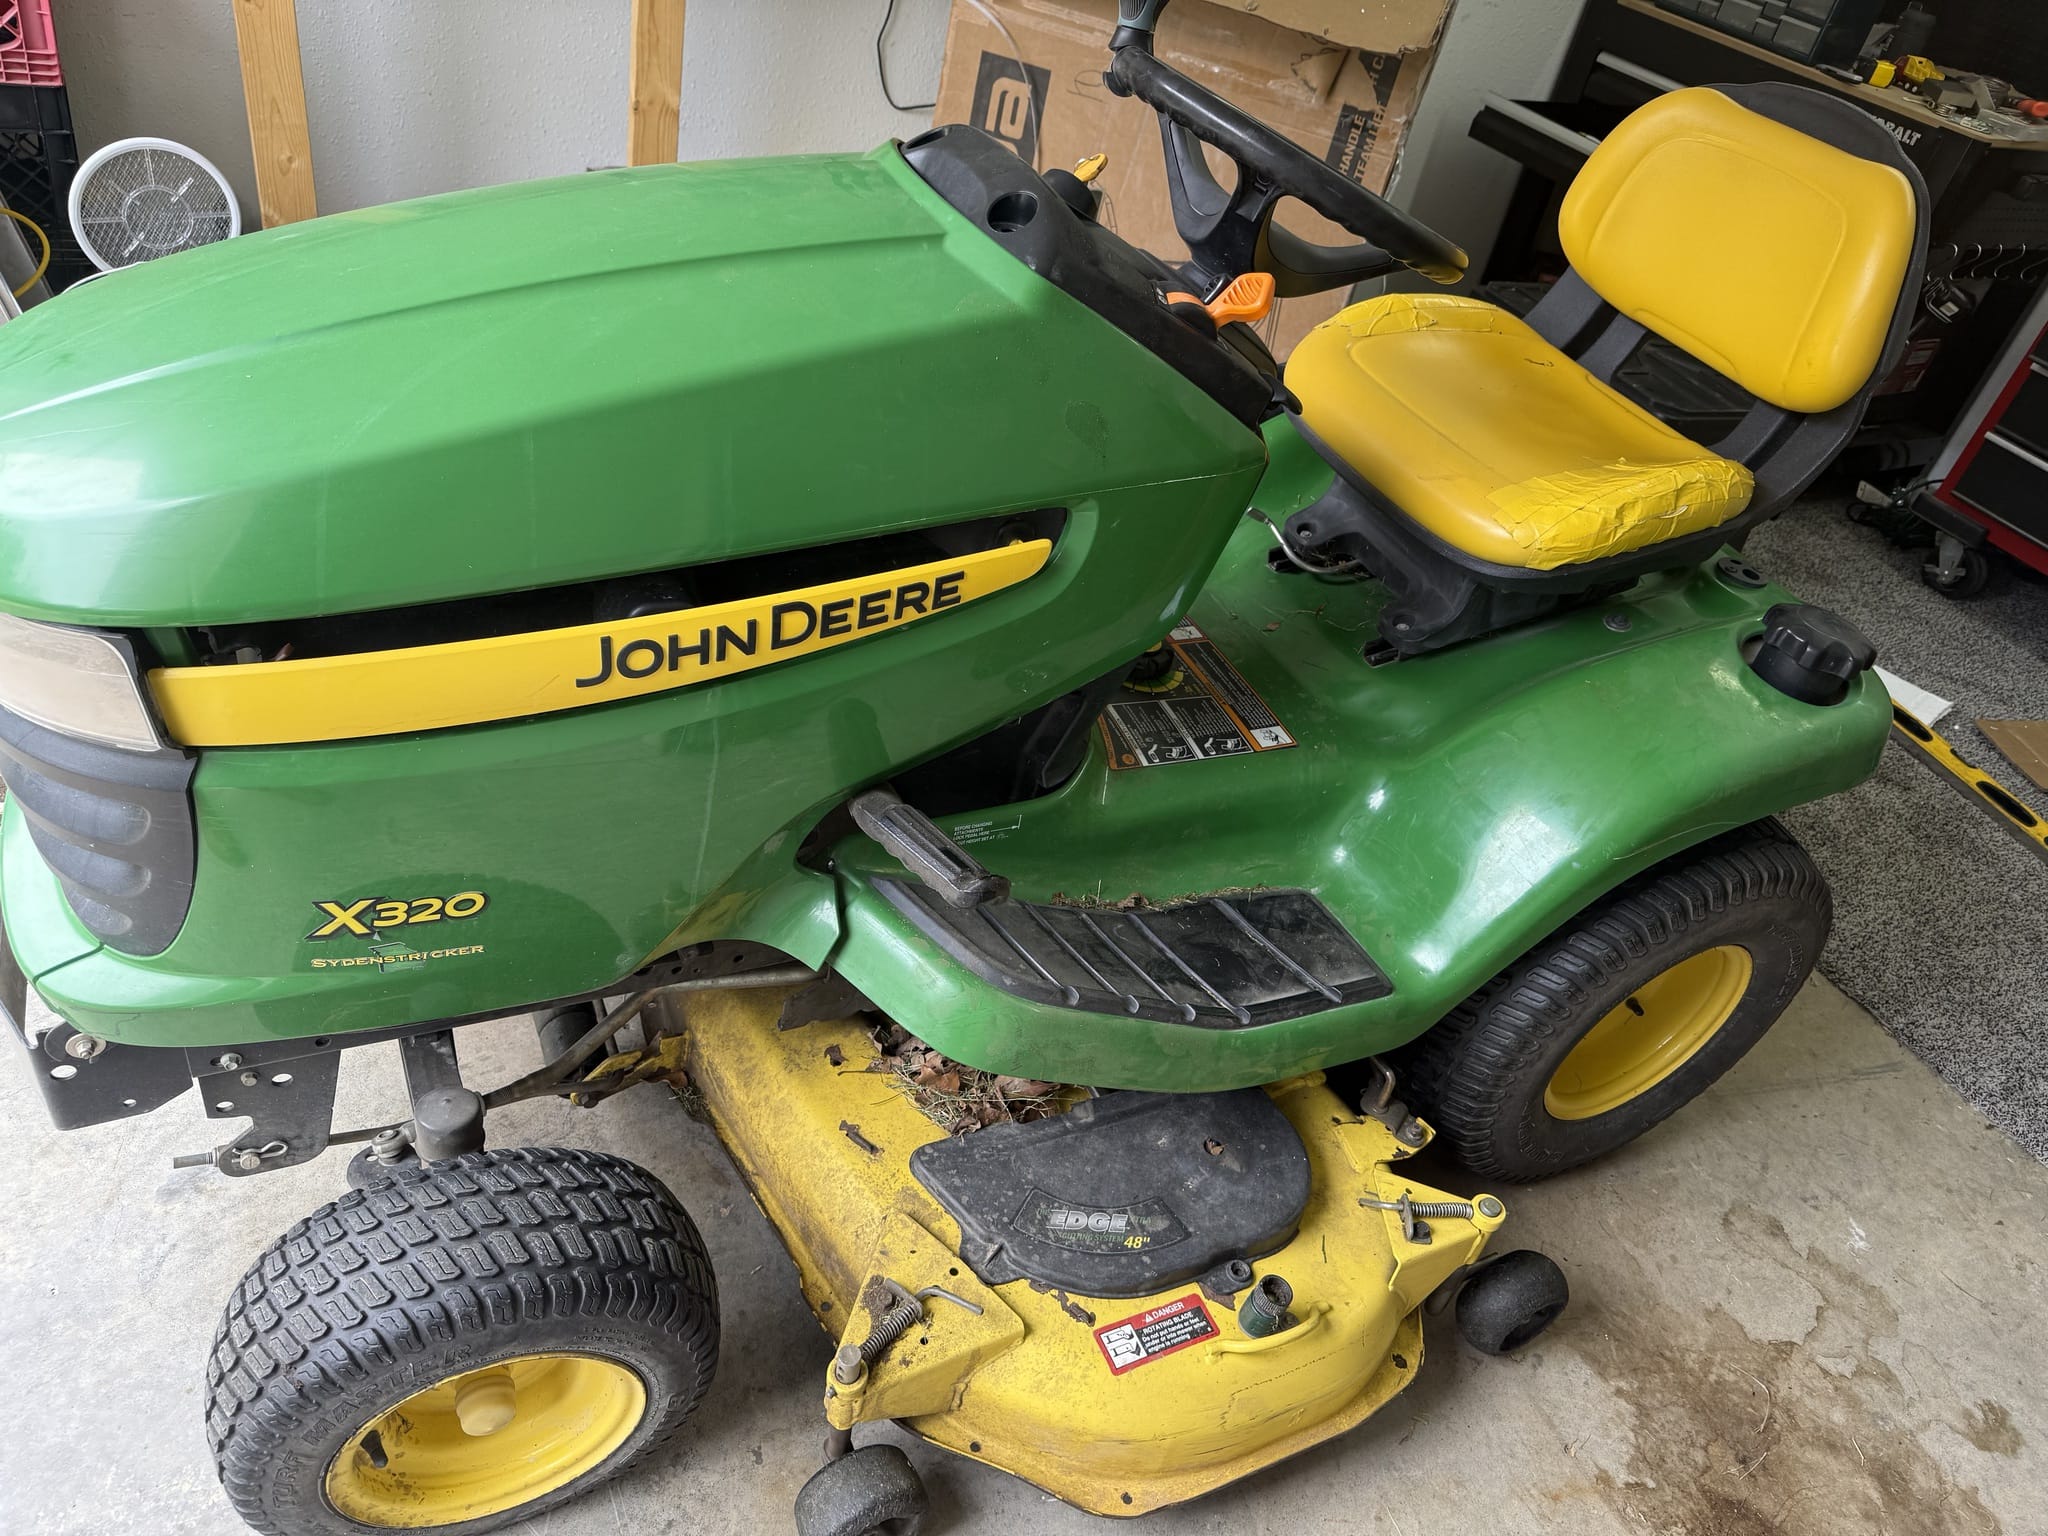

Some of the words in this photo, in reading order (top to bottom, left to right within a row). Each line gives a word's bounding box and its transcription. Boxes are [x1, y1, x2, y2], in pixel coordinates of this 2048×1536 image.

[1338, 114, 1365, 175] HANDLE
[1873, 116, 1921, 146] BALT
[1354, 140, 1375, 179] TEAM
[575, 618, 758, 689] JOHN
[770, 570, 965, 651] DEERE
[304, 891, 490, 940] X320
[310, 945, 484, 968] SYDENSTRICKER
[1047, 1209, 1130, 1234] EDGE
[1123, 1235, 1151, 1249] 48"
[1143, 1319, 1173, 1335] ROTATING
[1173, 1312, 1193, 1323] BLADE
[1152, 1302, 1185, 1319] DANGER
[272, 1450, 303, 1508] TURF
